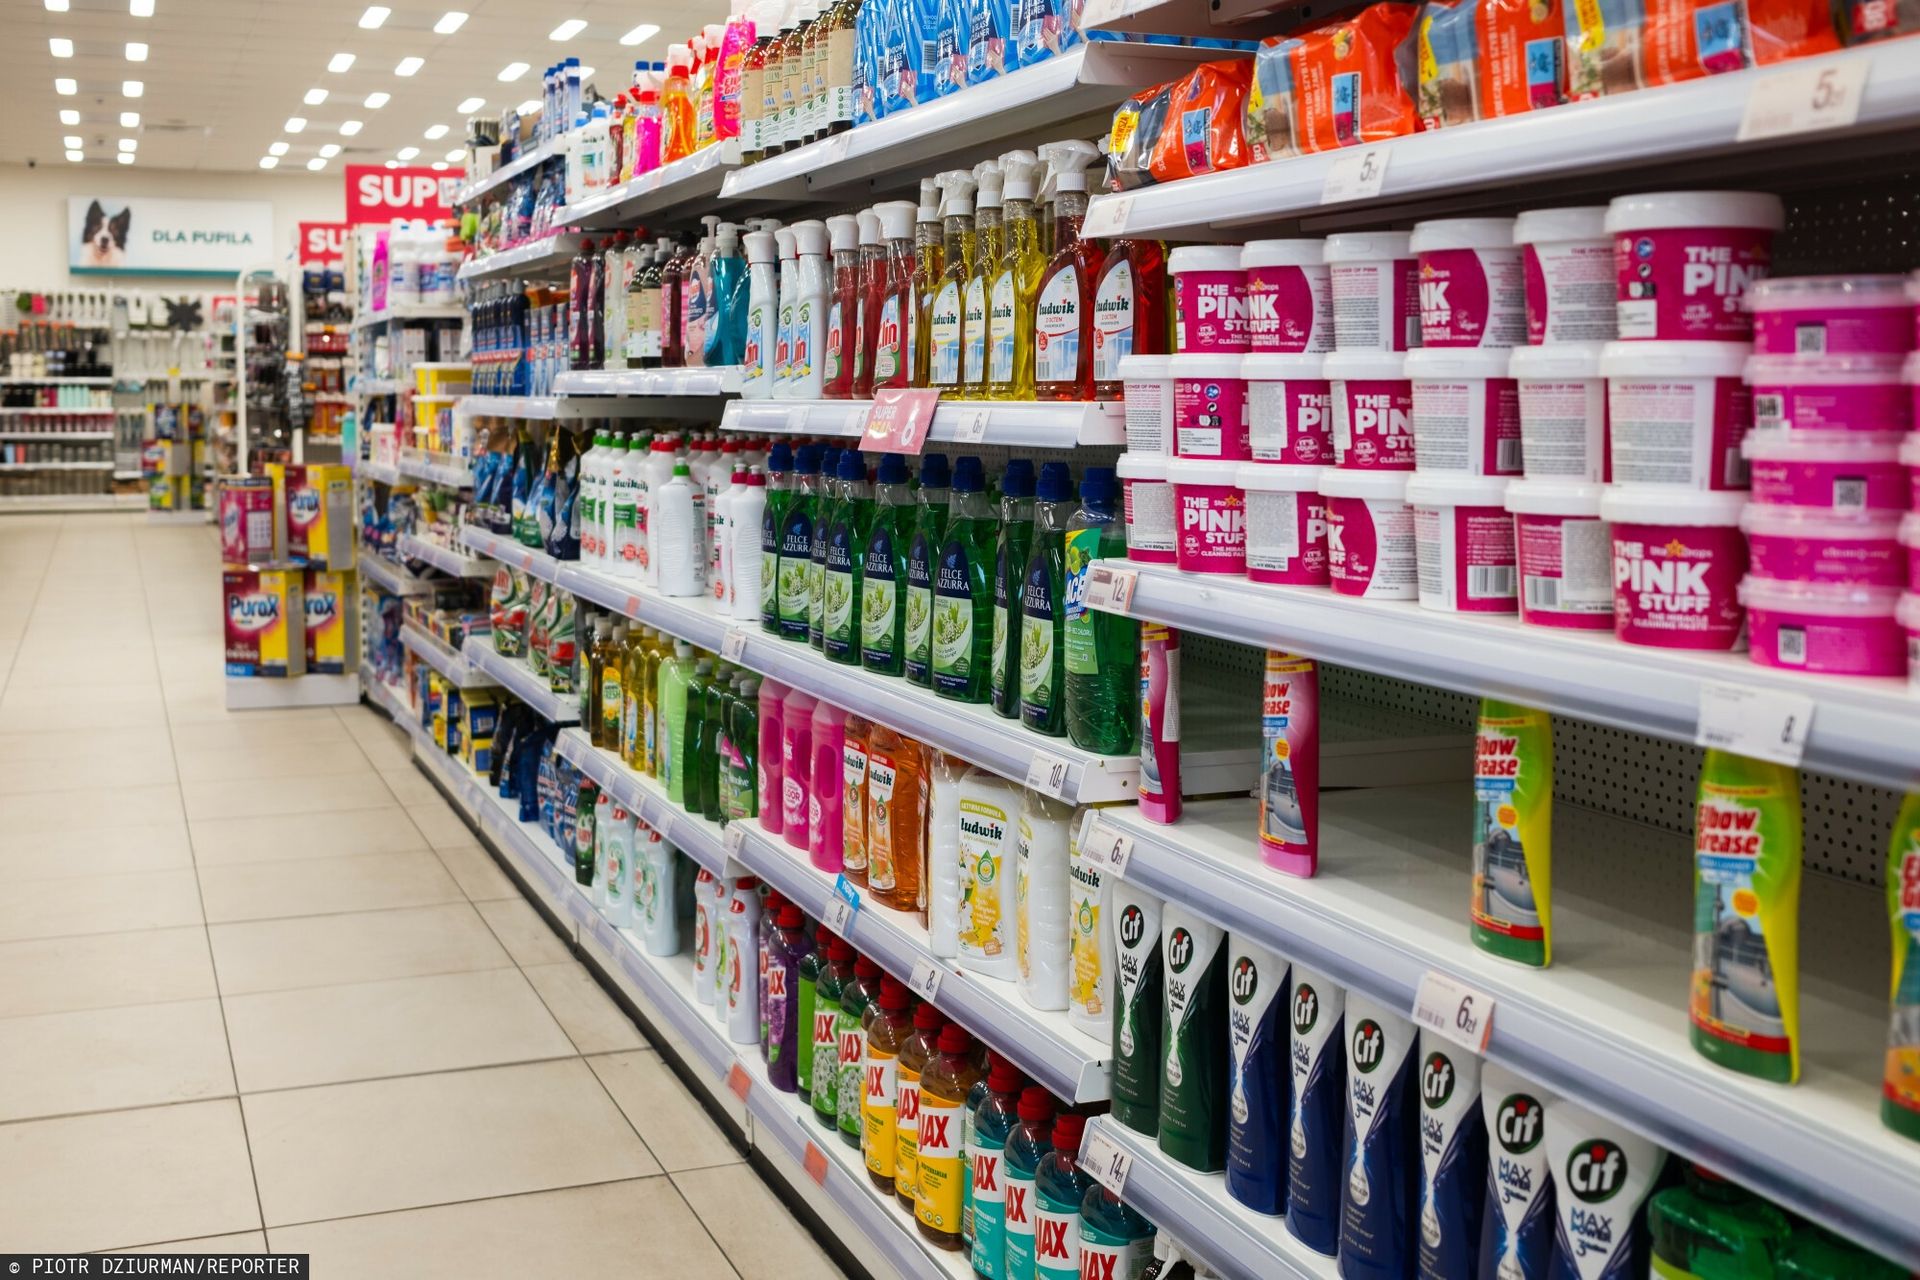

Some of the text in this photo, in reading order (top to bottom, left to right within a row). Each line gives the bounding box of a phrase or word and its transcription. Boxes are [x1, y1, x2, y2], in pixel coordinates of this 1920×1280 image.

[152, 229, 253, 245] DLA PUPILA
[1684, 246, 1732, 262] THE
[1198, 284, 1229, 296] THE
[1039, 298, 1075, 316] ludwik
[1354, 395, 1390, 408] THE
[1183, 496, 1209, 509] THE
[1183, 508, 1246, 532] PINK
[786, 534, 808, 544] FELCE
[830, 546, 846, 557] FELCE
[869, 553, 887, 564] FELCE
[1614, 540, 1644, 559] THE
[866, 562, 893, 574] AZZURRA
[911, 559, 924, 571] FELCE
[941, 569, 963, 580] FELCE
[1615, 557, 1712, 595] PINK
[936, 578, 970, 592] AZZURRA
[1027, 585, 1046, 598] FELCE
[1639, 592, 1711, 614] STUFF
[961, 818, 1002, 840] ludwik
[1110, 838, 1123, 865] 6zł
[1121, 908, 1141, 941] Cif
[1169, 931, 1190, 965] Cif
[1122, 952, 1138, 967] MAX
[1121, 963, 1137, 976] POWER
[1233, 959, 1254, 996] Cif
[1169, 977, 1186, 992] MAX
[1294, 986, 1316, 1026] Cif
[1456, 995, 1477, 1034] 6zł
[1232, 1008, 1250, 1023] MAX
[1354, 1022, 1380, 1063] Cif
[1353, 1076, 1375, 1095] MAX
[1423, 1056, 1450, 1099] Cif
[1423, 1112, 1443, 1130] MAX
[1500, 1100, 1538, 1144] Cif
[1110, 1152, 1125, 1183] 14zł
[1499, 1157, 1532, 1182] MAX
[1570, 1144, 1619, 1193] Cif
[1571, 1206, 1612, 1231] MAX
